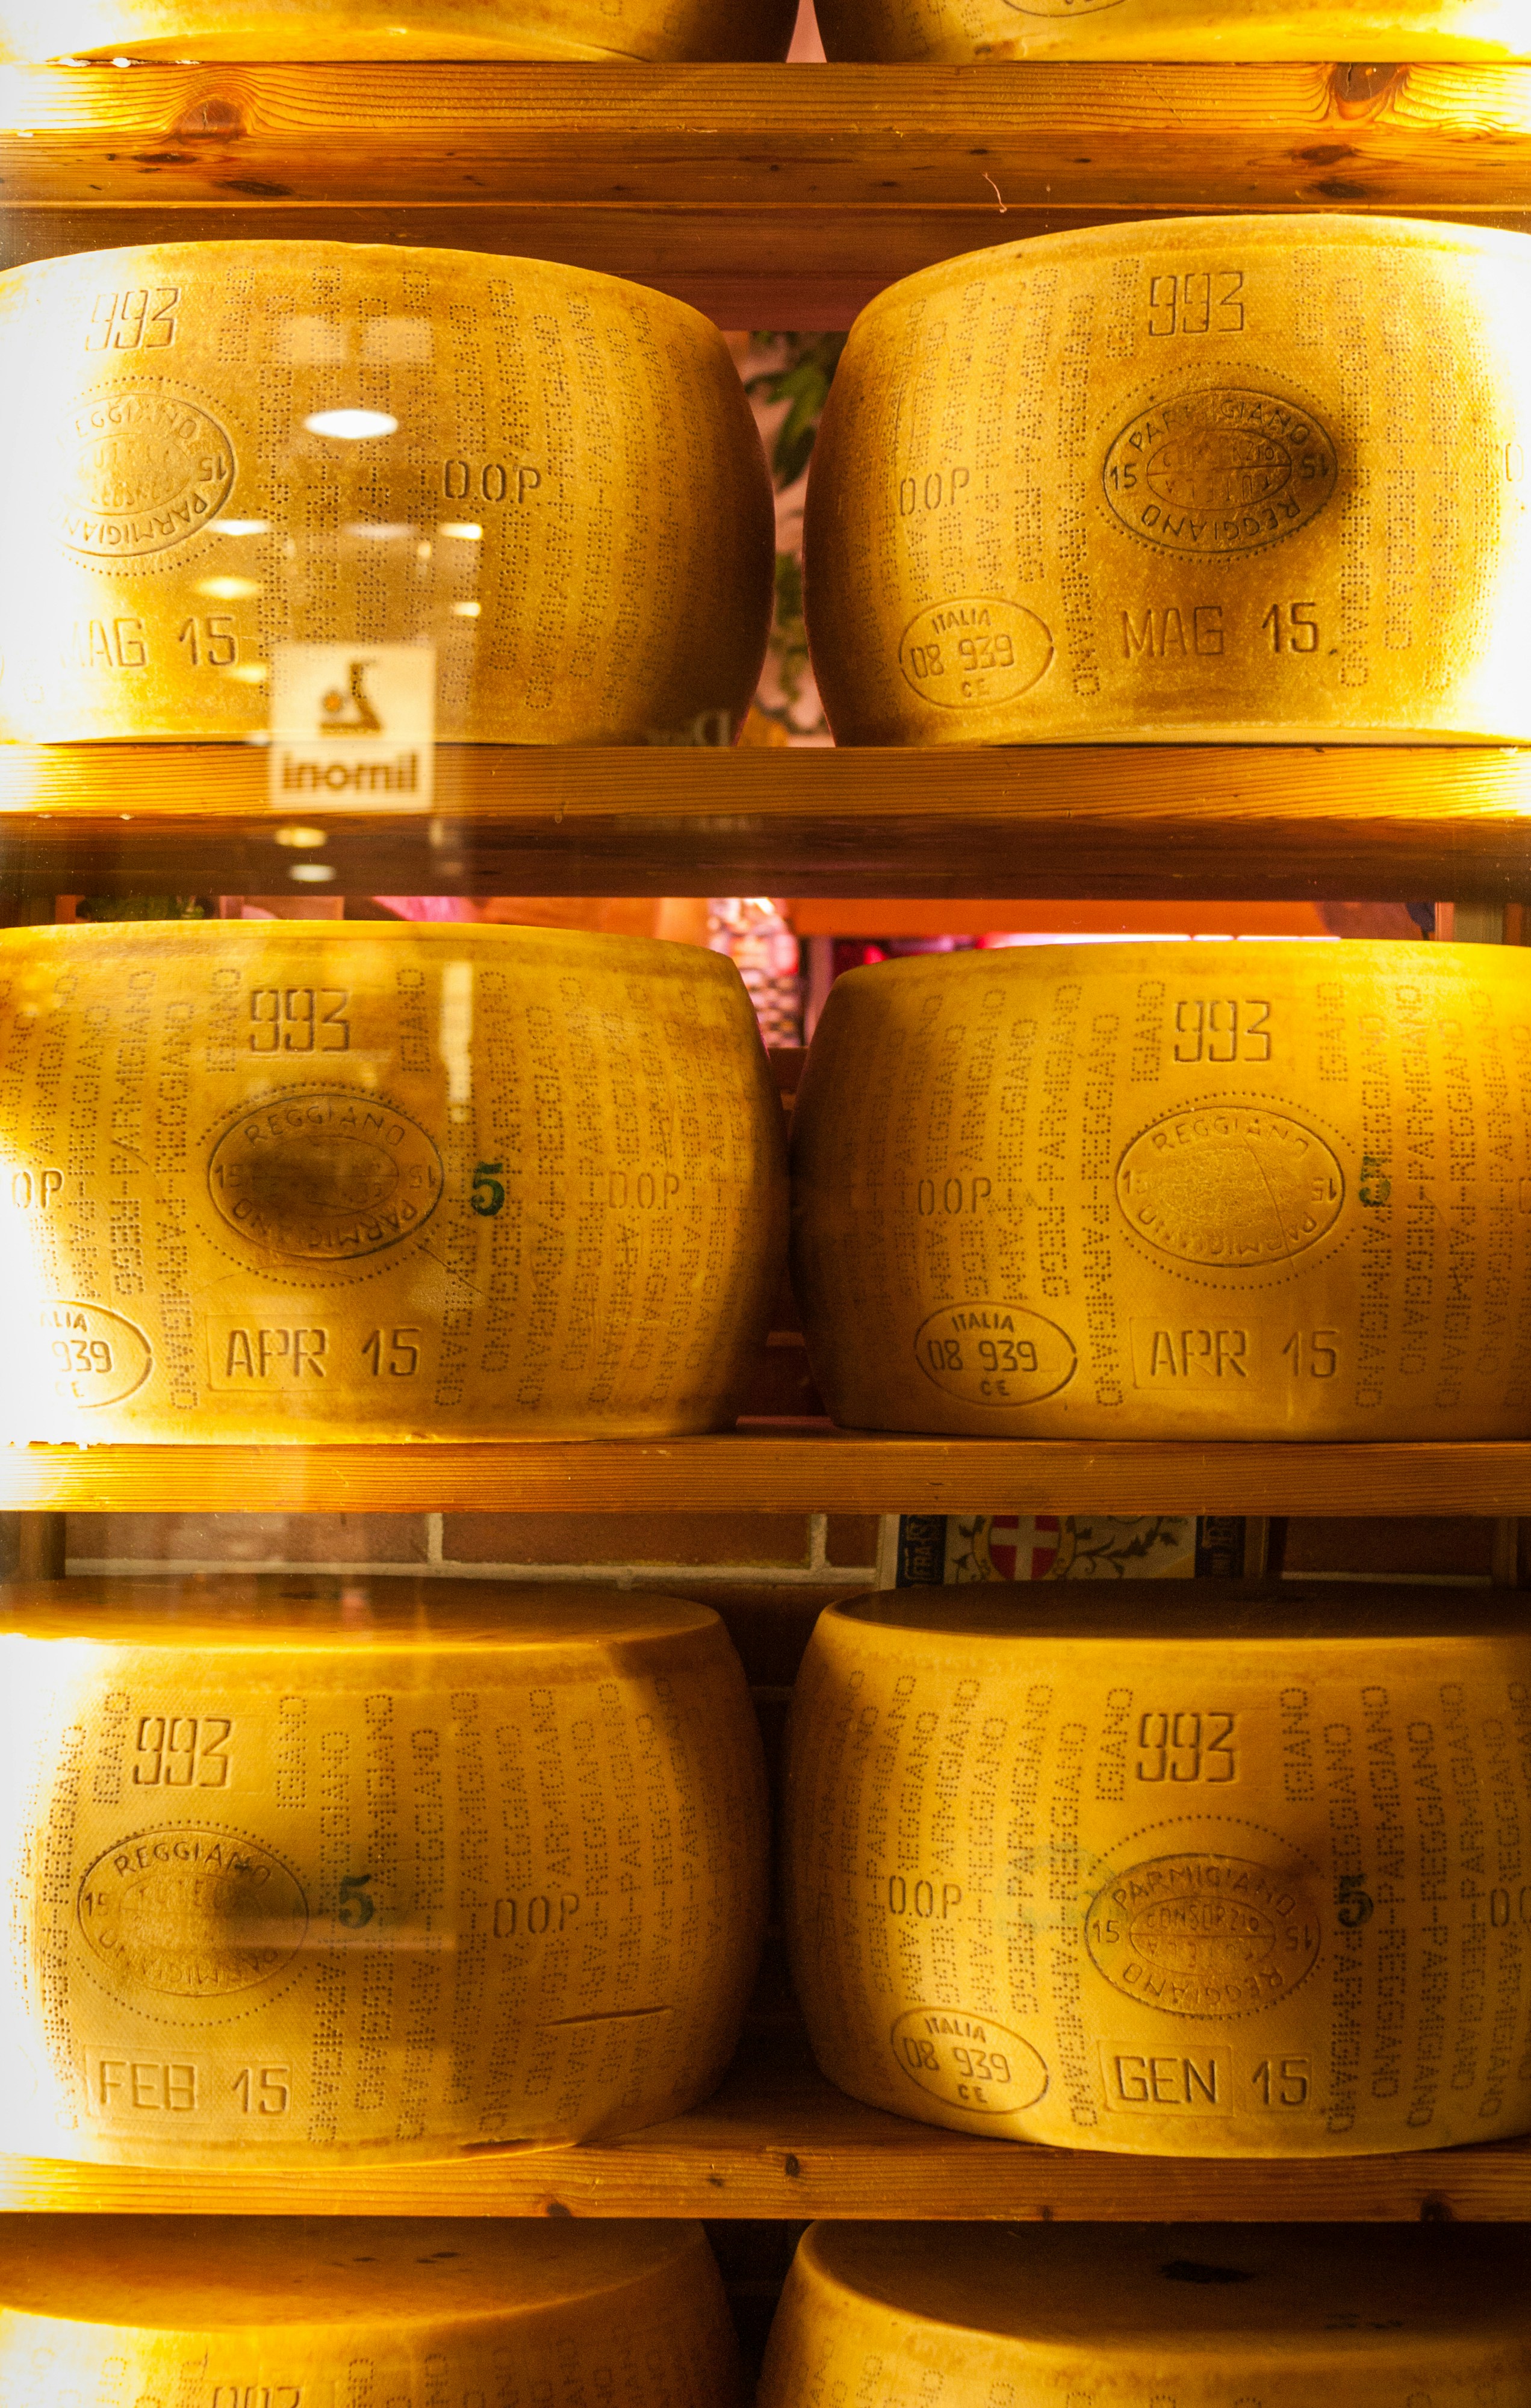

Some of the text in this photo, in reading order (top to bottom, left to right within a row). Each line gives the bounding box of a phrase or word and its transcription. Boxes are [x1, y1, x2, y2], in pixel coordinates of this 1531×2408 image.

[85, 288, 180, 351] 993
[1149, 271, 1244, 337] 993
[1110, 463, 1138, 491] 15
[1141, 494, 1301, 541] REGGIANO
[178, 616, 237, 667] 15
[932, 608, 992, 635] ITALIA
[1120, 603, 1319, 658] MAG 15
[910, 634, 1014, 679] 08 939
[962, 678, 990, 698] CE
[249, 988, 351, 1053] 993
[1174, 1000, 1272, 1063] 993
[243, 1106, 406, 1146] REGGIANO
[1151, 1117, 1309, 1157] REGGIANO
[471, 1161, 505, 1216] 5
[952, 1312, 1015, 1332] ITALIA
[52, 1340, 113, 1373] 939
[227, 1327, 419, 1377] APR 15
[928, 1340, 1039, 1373] 08 939
[1151, 1329, 1340, 1378] APR 15
[980, 1379, 1010, 1397] CE
[134, 1716, 232, 1788] 993
[1137, 1713, 1238, 1784] 993
[114, 1841, 272, 1885] REGGIANO
[338, 1875, 374, 1929] 5
[1112, 1866, 1296, 1917] PARMIGIANO
[1337, 1872, 1374, 1928] 5
[1093, 1920, 1120, 1944] 15
[925, 2017, 987, 2044] ITALIA
[903, 2037, 1011, 2083] 08 939
[1116, 2056, 1309, 2107] GEN 15
[99, 2060, 290, 2115] FEB 15
[960, 2086, 990, 2105] CE
